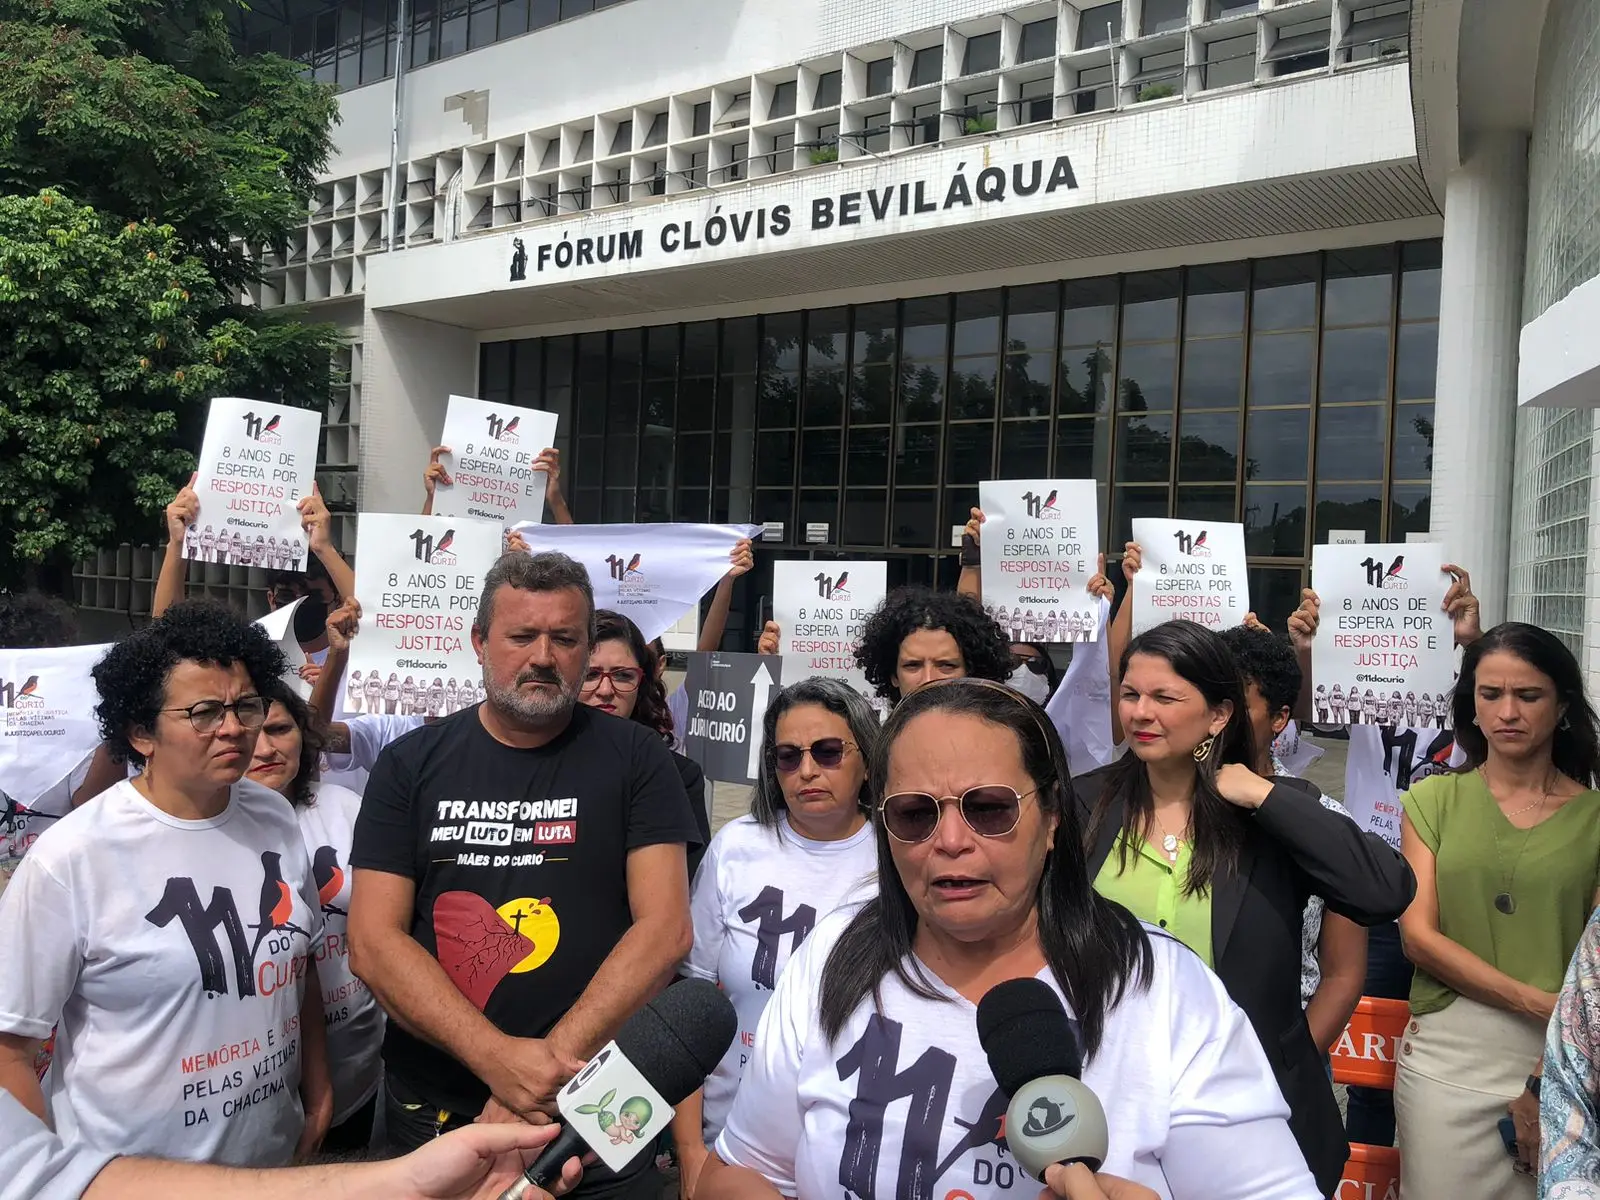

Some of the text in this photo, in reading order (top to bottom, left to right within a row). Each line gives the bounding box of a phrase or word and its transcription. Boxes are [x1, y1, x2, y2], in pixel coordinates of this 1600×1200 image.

[537, 155, 1079, 271] FÓRUM CLÓVIS BEVILÁQUA
[222, 446, 296, 466] 8 ANOS DE
[466, 444, 530, 464] 8 ANOS DE
[217, 462, 298, 483] ESPERA POR
[460, 458, 532, 480] ESPERA POR
[211, 479, 299, 500] RESPOSTAS E
[455, 472, 533, 496] RESPOSTAS E
[226, 499, 282, 517] JUSTIÇA
[468, 492, 517, 510] JUSTIÇA
[227, 517, 268, 529] @11docurio
[1007, 527, 1076, 539] 8 ANOS DE
[1003, 544, 1081, 556] ESPERA POR
[431, 554, 457, 566] CURIÓ
[1000, 561, 1085, 572] RESPOSTAS E
[1160, 564, 1227, 576] 8 ANOS DE
[388, 573, 475, 590] 8 ANOS DE
[1017, 577, 1070, 590] JUSTIÇA
[1156, 579, 1232, 591] ESPERA POR
[1383, 580, 1409, 590] CURIÓ
[382, 594, 478, 610] ESPERA POR
[1019, 596, 1059, 604] @11docurio
[1152, 595, 1236, 607] RESPOSTAS E
[1343, 598, 1427, 611] 8 ANOS DE
[799, 608, 865, 620] 8 ANOS DE
[376, 614, 463, 631] RESPOSTAS
[795, 625, 840, 636] ESPERA
[1339, 616, 1432, 630] ESPERA POR
[395, 636, 462, 654] JUSTIÇA
[792, 641, 861, 653] RESPOSTAS
[1334, 635, 1436, 649] RESPOSTAS E
[396, 659, 447, 670] @11docurio
[1354, 654, 1418, 670] JUSTIÇA
[1356, 674, 1404, 684] @11docurio
[15, 700, 44, 709] CURIÓ
[717, 692, 736, 712] AO
[5, 728, 65, 736] #JUSTIÇAPELOCURIÓ
[688, 712, 746, 743] JÚRI CURIÓ
[437, 798, 578, 820] TRANSFORMEI
[1370, 815, 1393, 830] PELAS
[430, 825, 572, 842] MEU LUTO EM LUTA
[1382, 834, 1401, 848] CHAC
[457, 850, 546, 867] MÃES DO CURIÓ
[268, 936, 290, 955] DO
[258, 956, 307, 996] CURI
[181, 1038, 260, 1074] MEMÓRIA
[267, 1029, 274, 1046] E
[183, 1039, 296, 1100] PELAS VÍTIMAS
[184, 1076, 285, 1127] DA CHACINA
[974, 1159, 1014, 1189] DO
